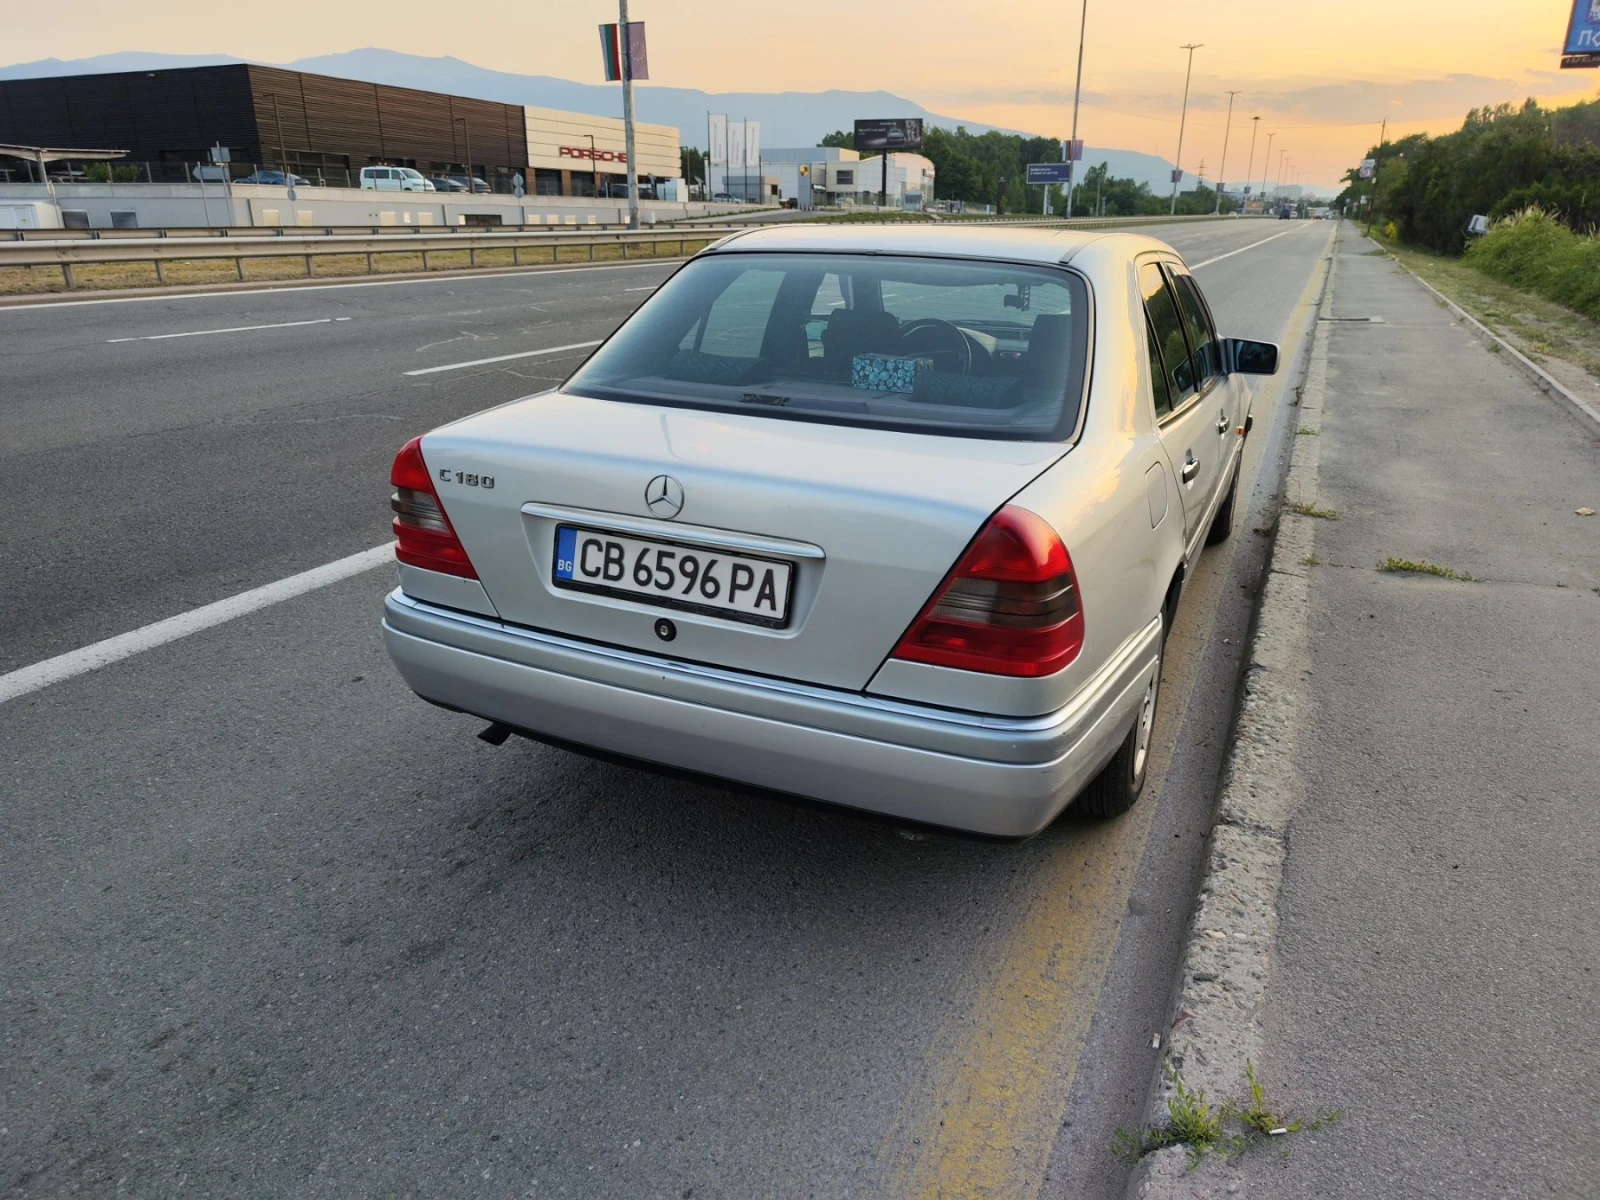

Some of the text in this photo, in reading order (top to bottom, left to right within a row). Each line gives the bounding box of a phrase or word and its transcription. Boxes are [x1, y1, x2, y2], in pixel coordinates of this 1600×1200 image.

[559, 147, 628, 163] PORSCHE
[439, 468, 495, 489] C 180
[557, 559, 572, 572] BG
[633, 547, 721, 599] 6596
